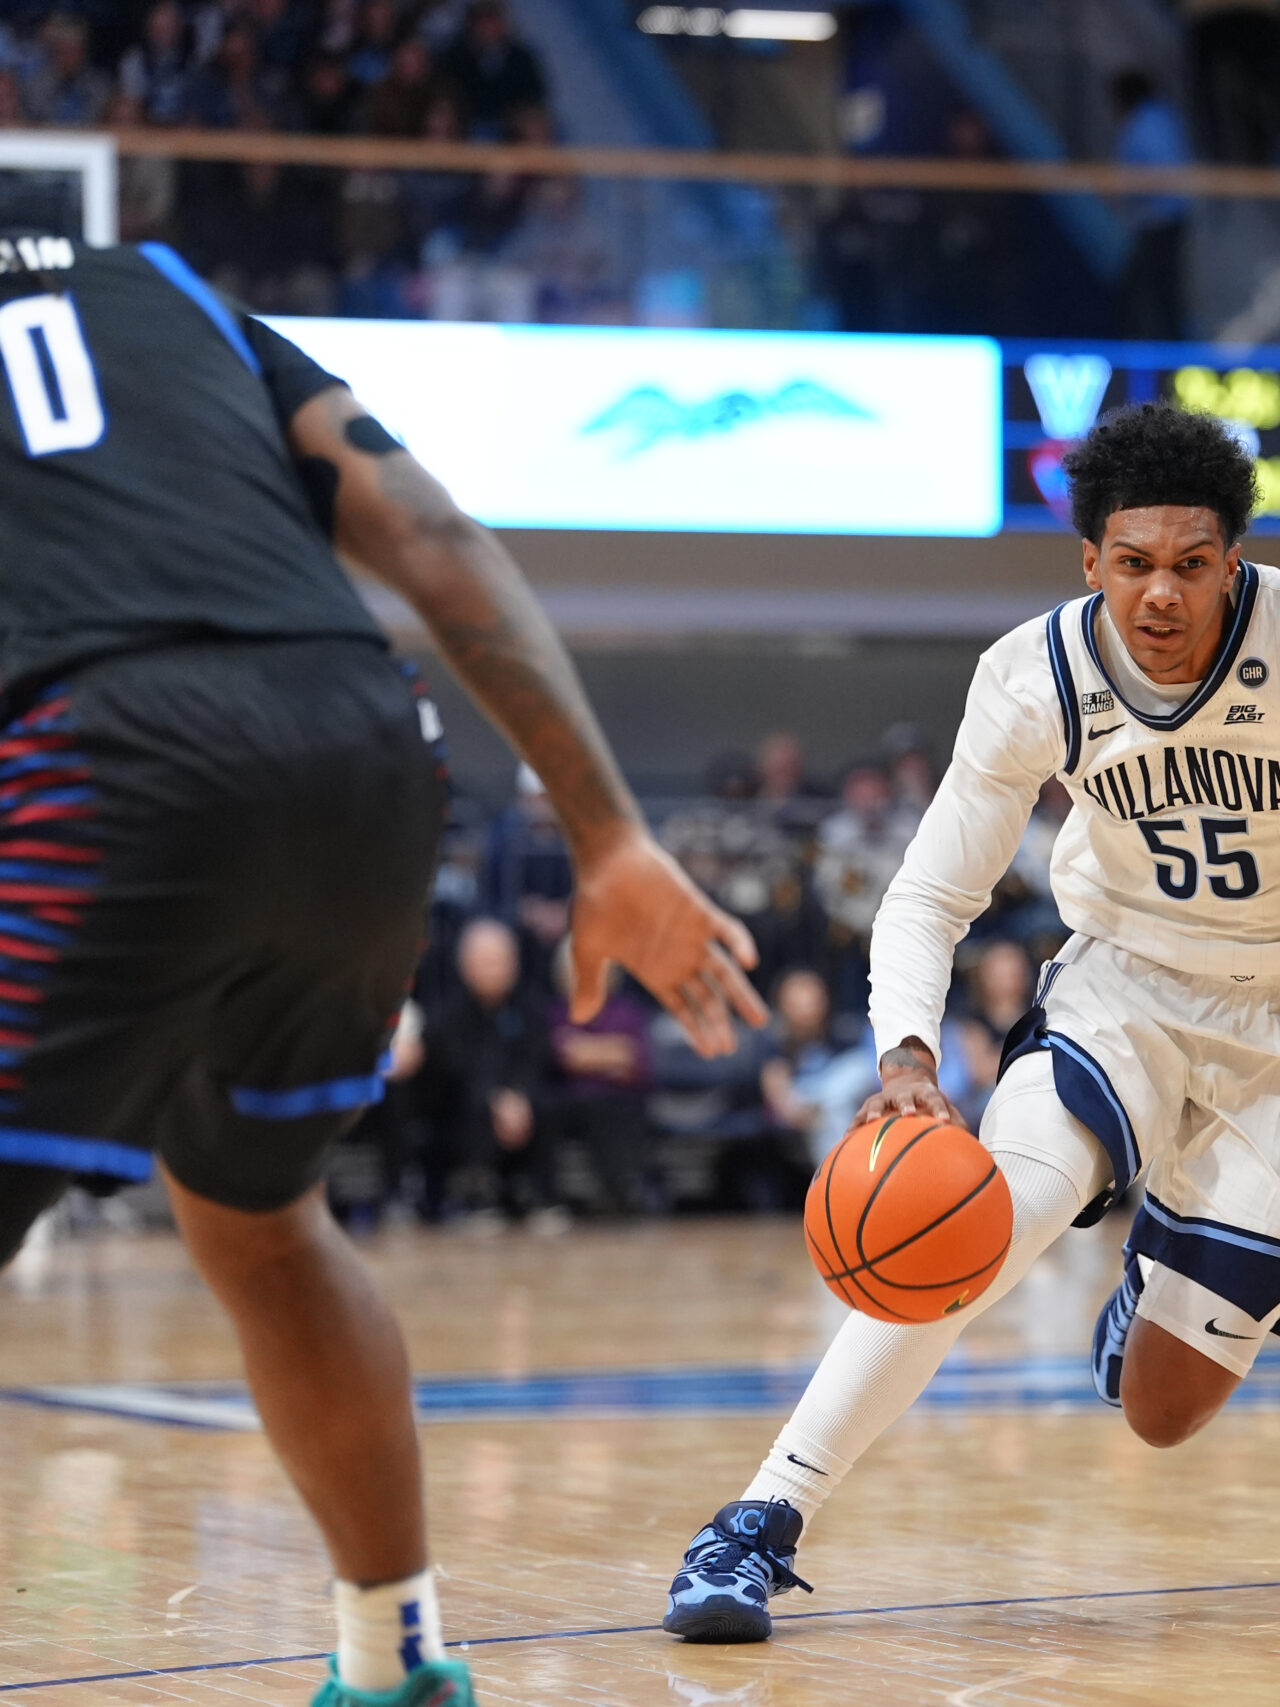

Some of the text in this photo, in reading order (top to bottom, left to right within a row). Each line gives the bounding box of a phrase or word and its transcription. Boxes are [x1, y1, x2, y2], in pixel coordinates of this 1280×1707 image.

[0, 292, 104, 456] 0
[1242, 666, 1263, 680] GHR
[1082, 690, 1112, 704] BE THE
[1229, 704, 1257, 713] BIG
[1225, 712, 1266, 721] EAST
[1136, 816, 1261, 901] 55
